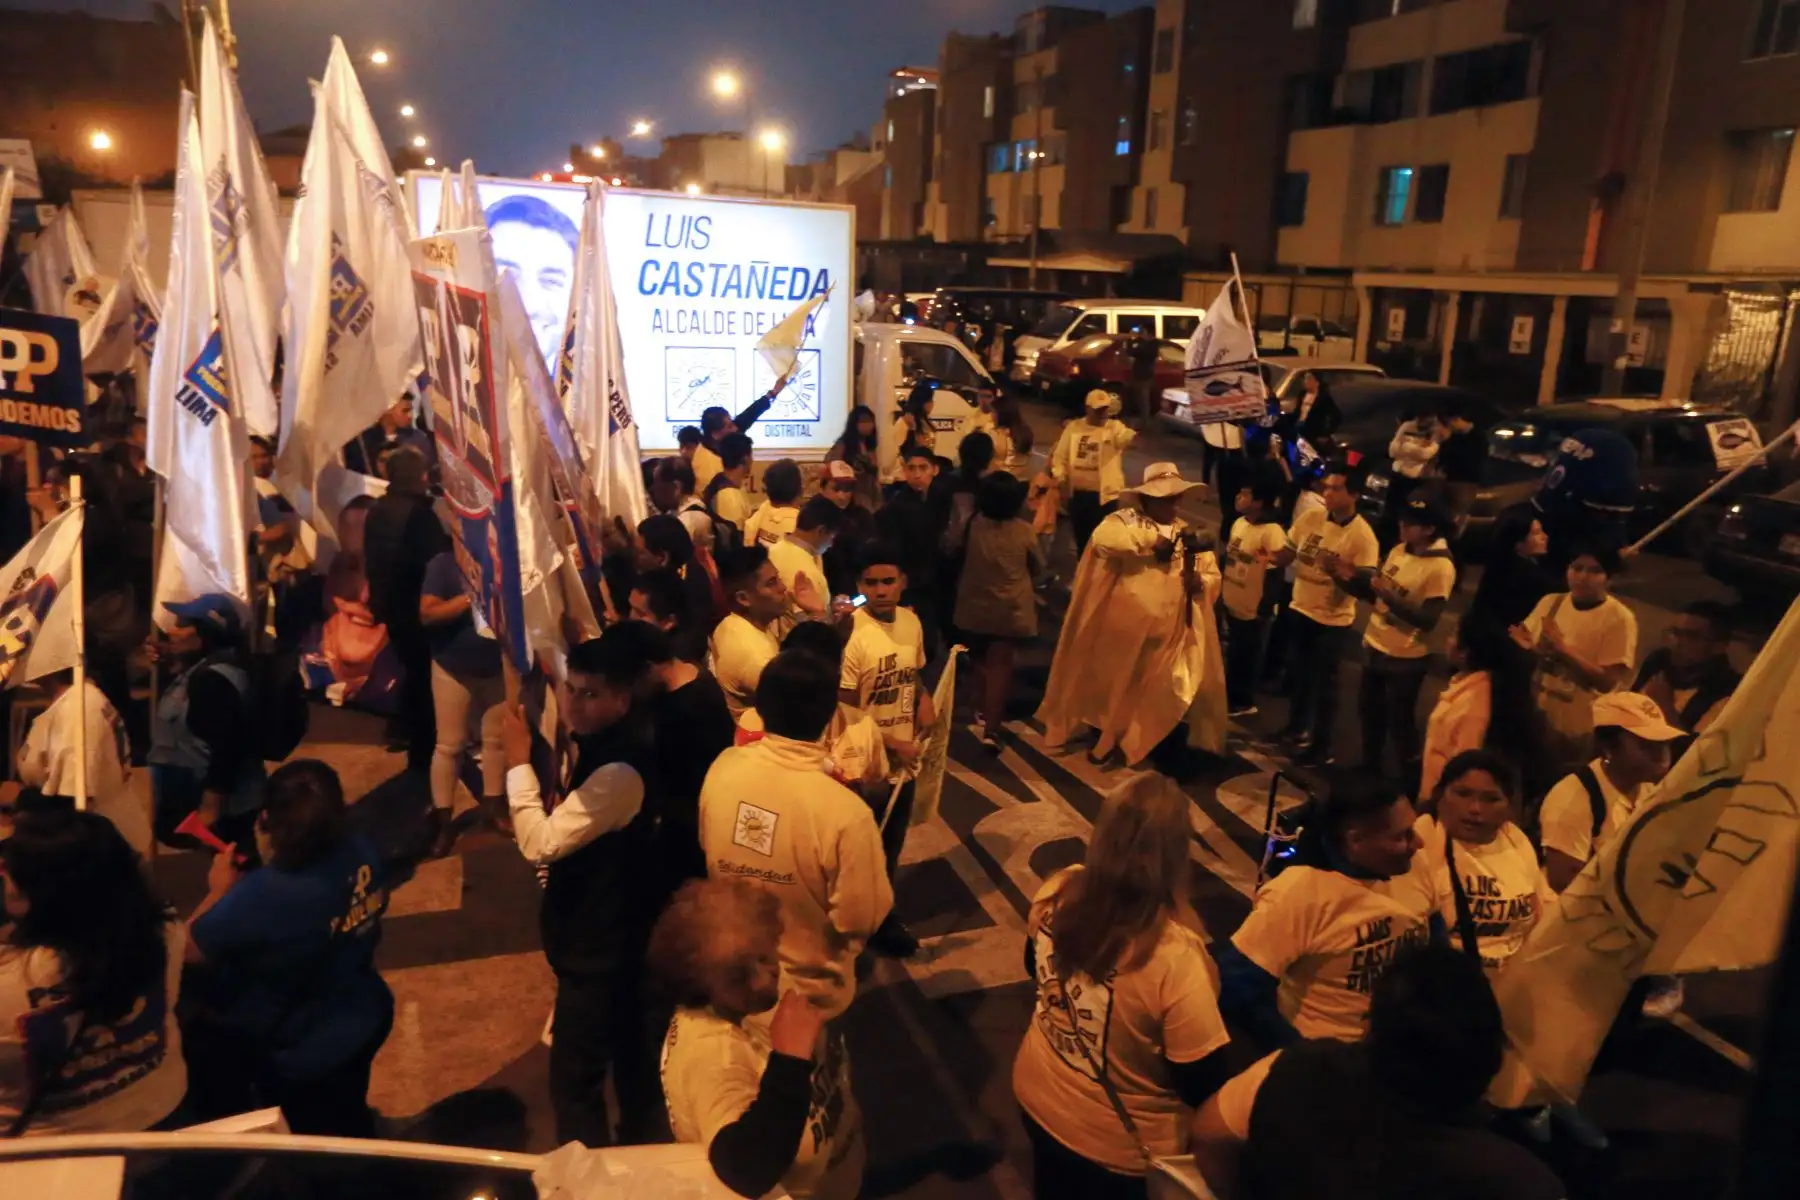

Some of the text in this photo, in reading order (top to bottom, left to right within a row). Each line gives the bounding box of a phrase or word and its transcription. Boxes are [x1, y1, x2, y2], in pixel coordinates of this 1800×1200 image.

[645, 212, 712, 250] LUIS
[638, 259, 830, 302] CASTAÑEDA
[652, 308, 816, 338] ALCALDE DE LA
[0, 399, 82, 433] DEMOS
[174, 384, 218, 427] LIMA
[764, 424, 812, 438] DISTRITAL
[878, 652, 898, 674] LUIS
[1465, 875, 1501, 897] LUIS
